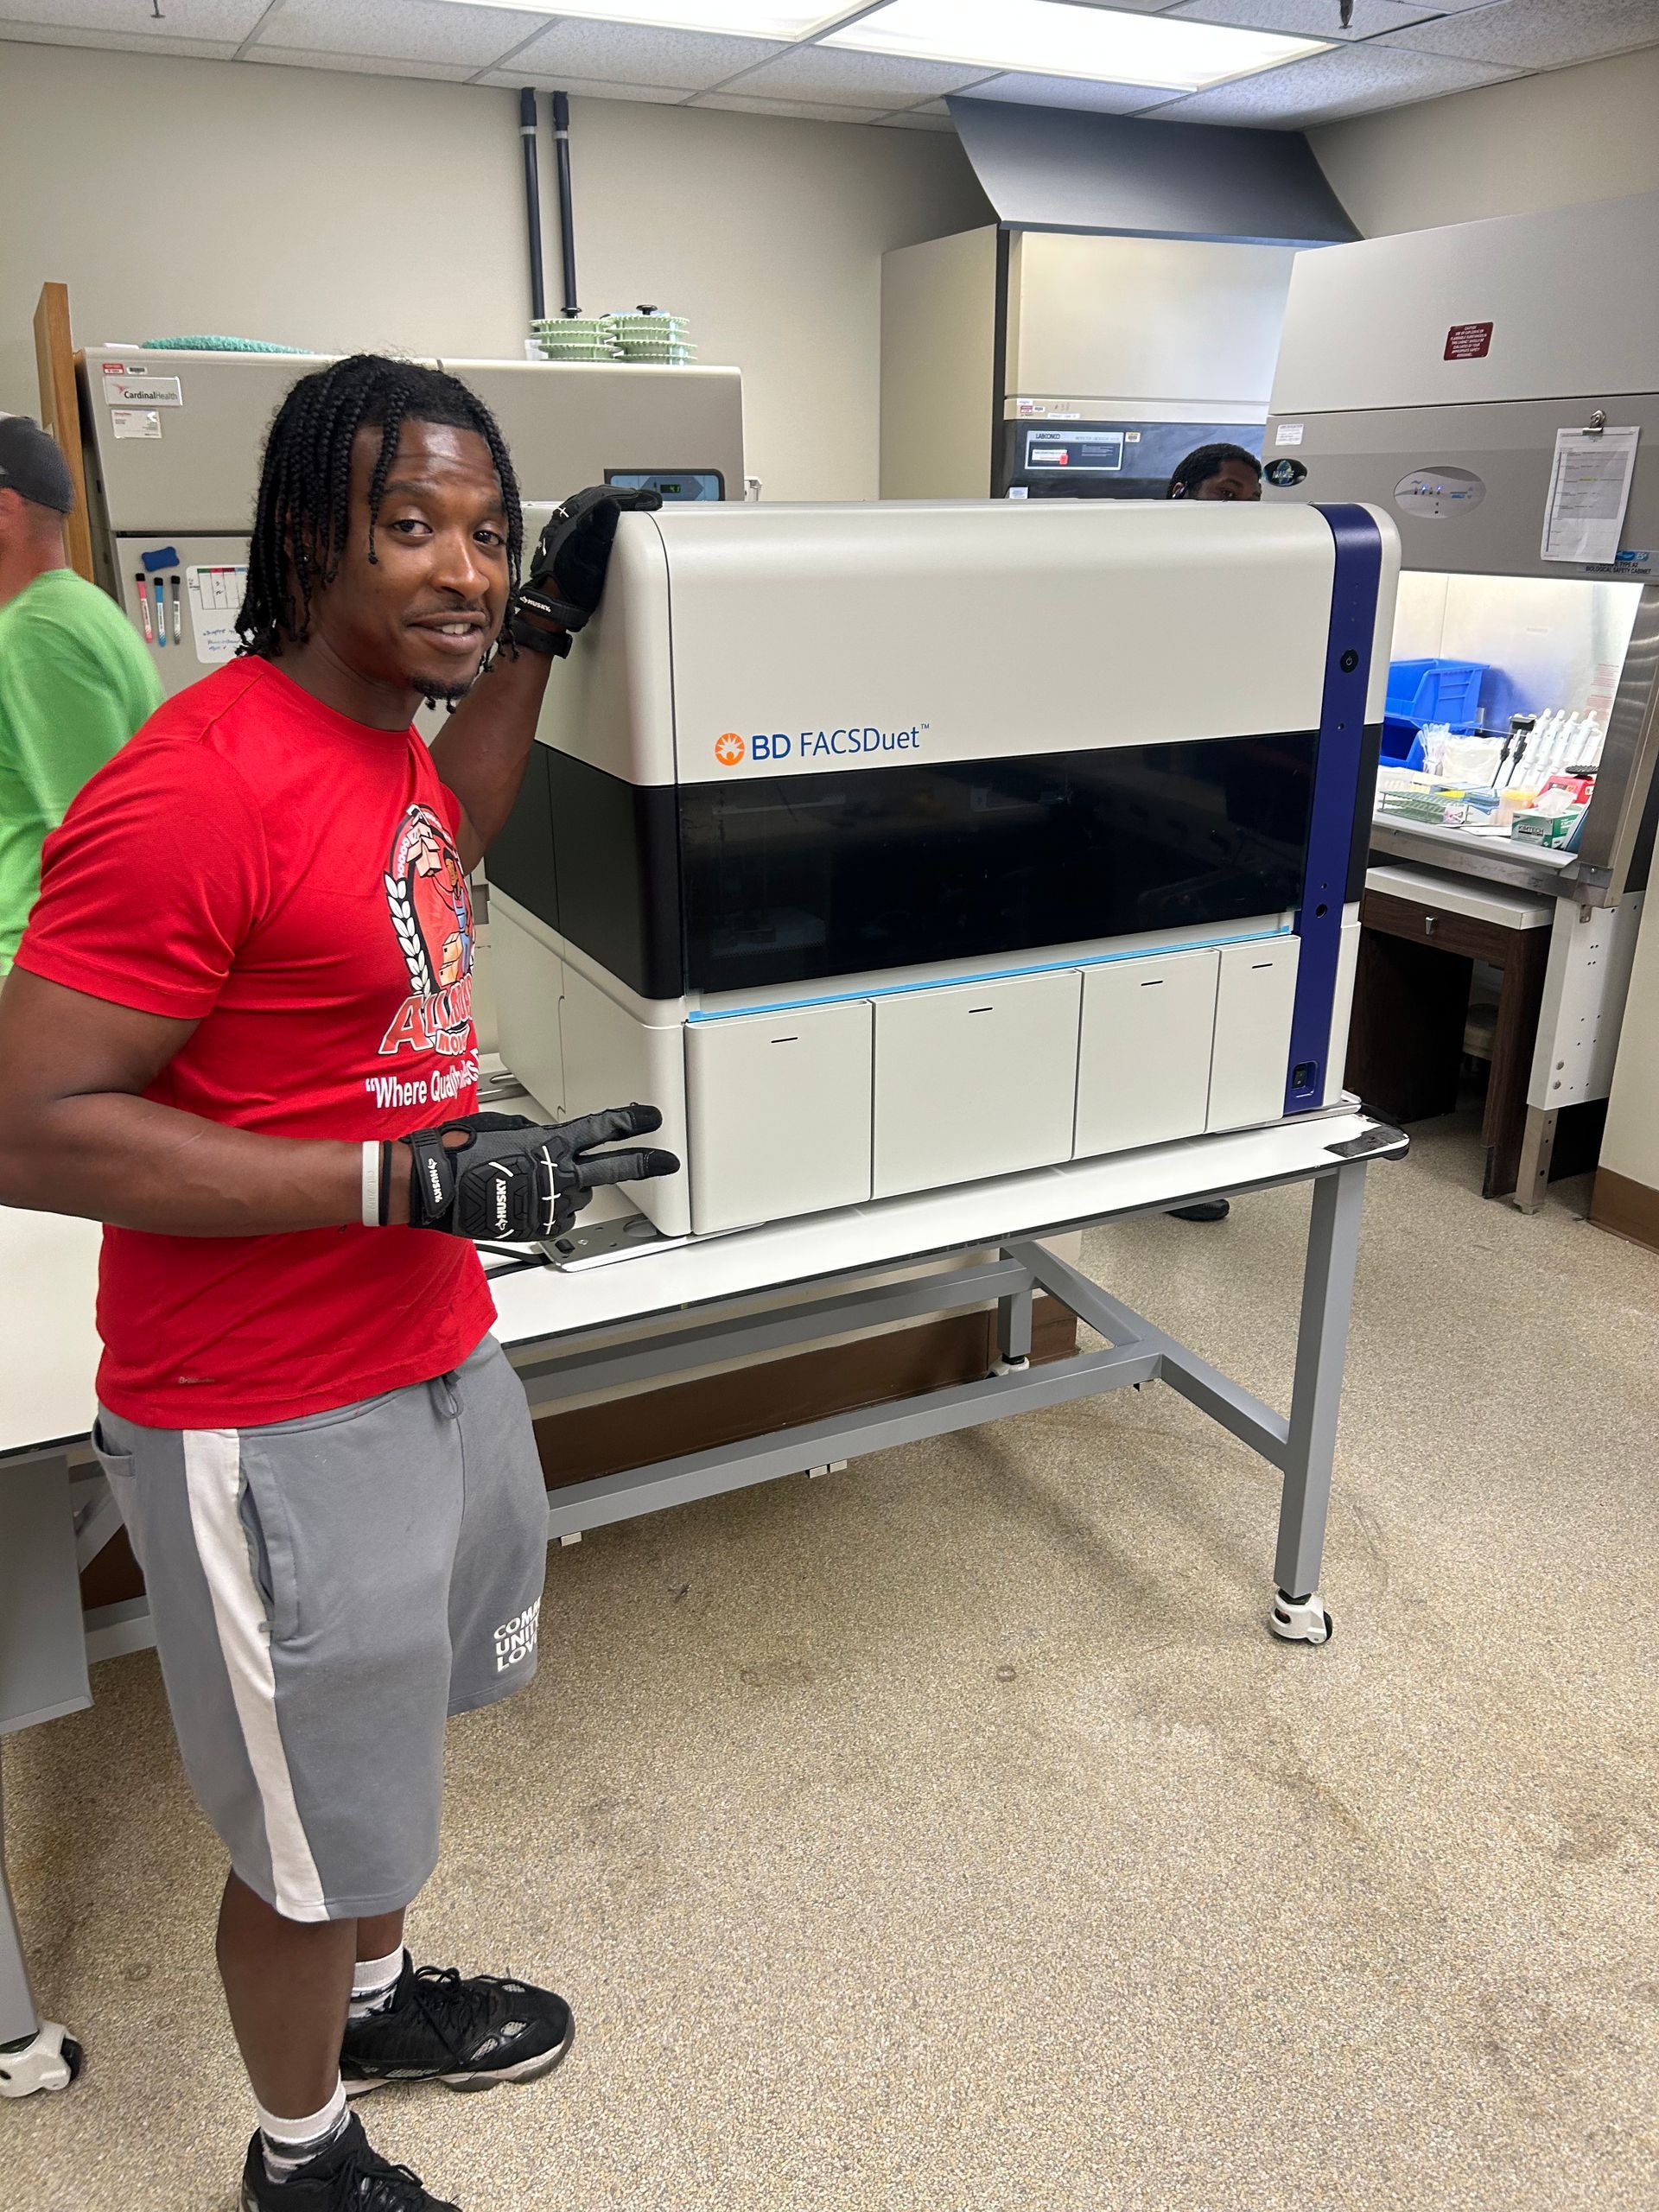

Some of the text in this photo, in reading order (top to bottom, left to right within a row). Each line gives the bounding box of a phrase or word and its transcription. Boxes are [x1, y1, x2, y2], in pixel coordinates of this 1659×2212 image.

[752, 734, 791, 760] BD
[429, 1169, 443, 1203] HUSKY
[495, 1178, 507, 1219] HUSKY
[497, 1633, 537, 1672] LOV
